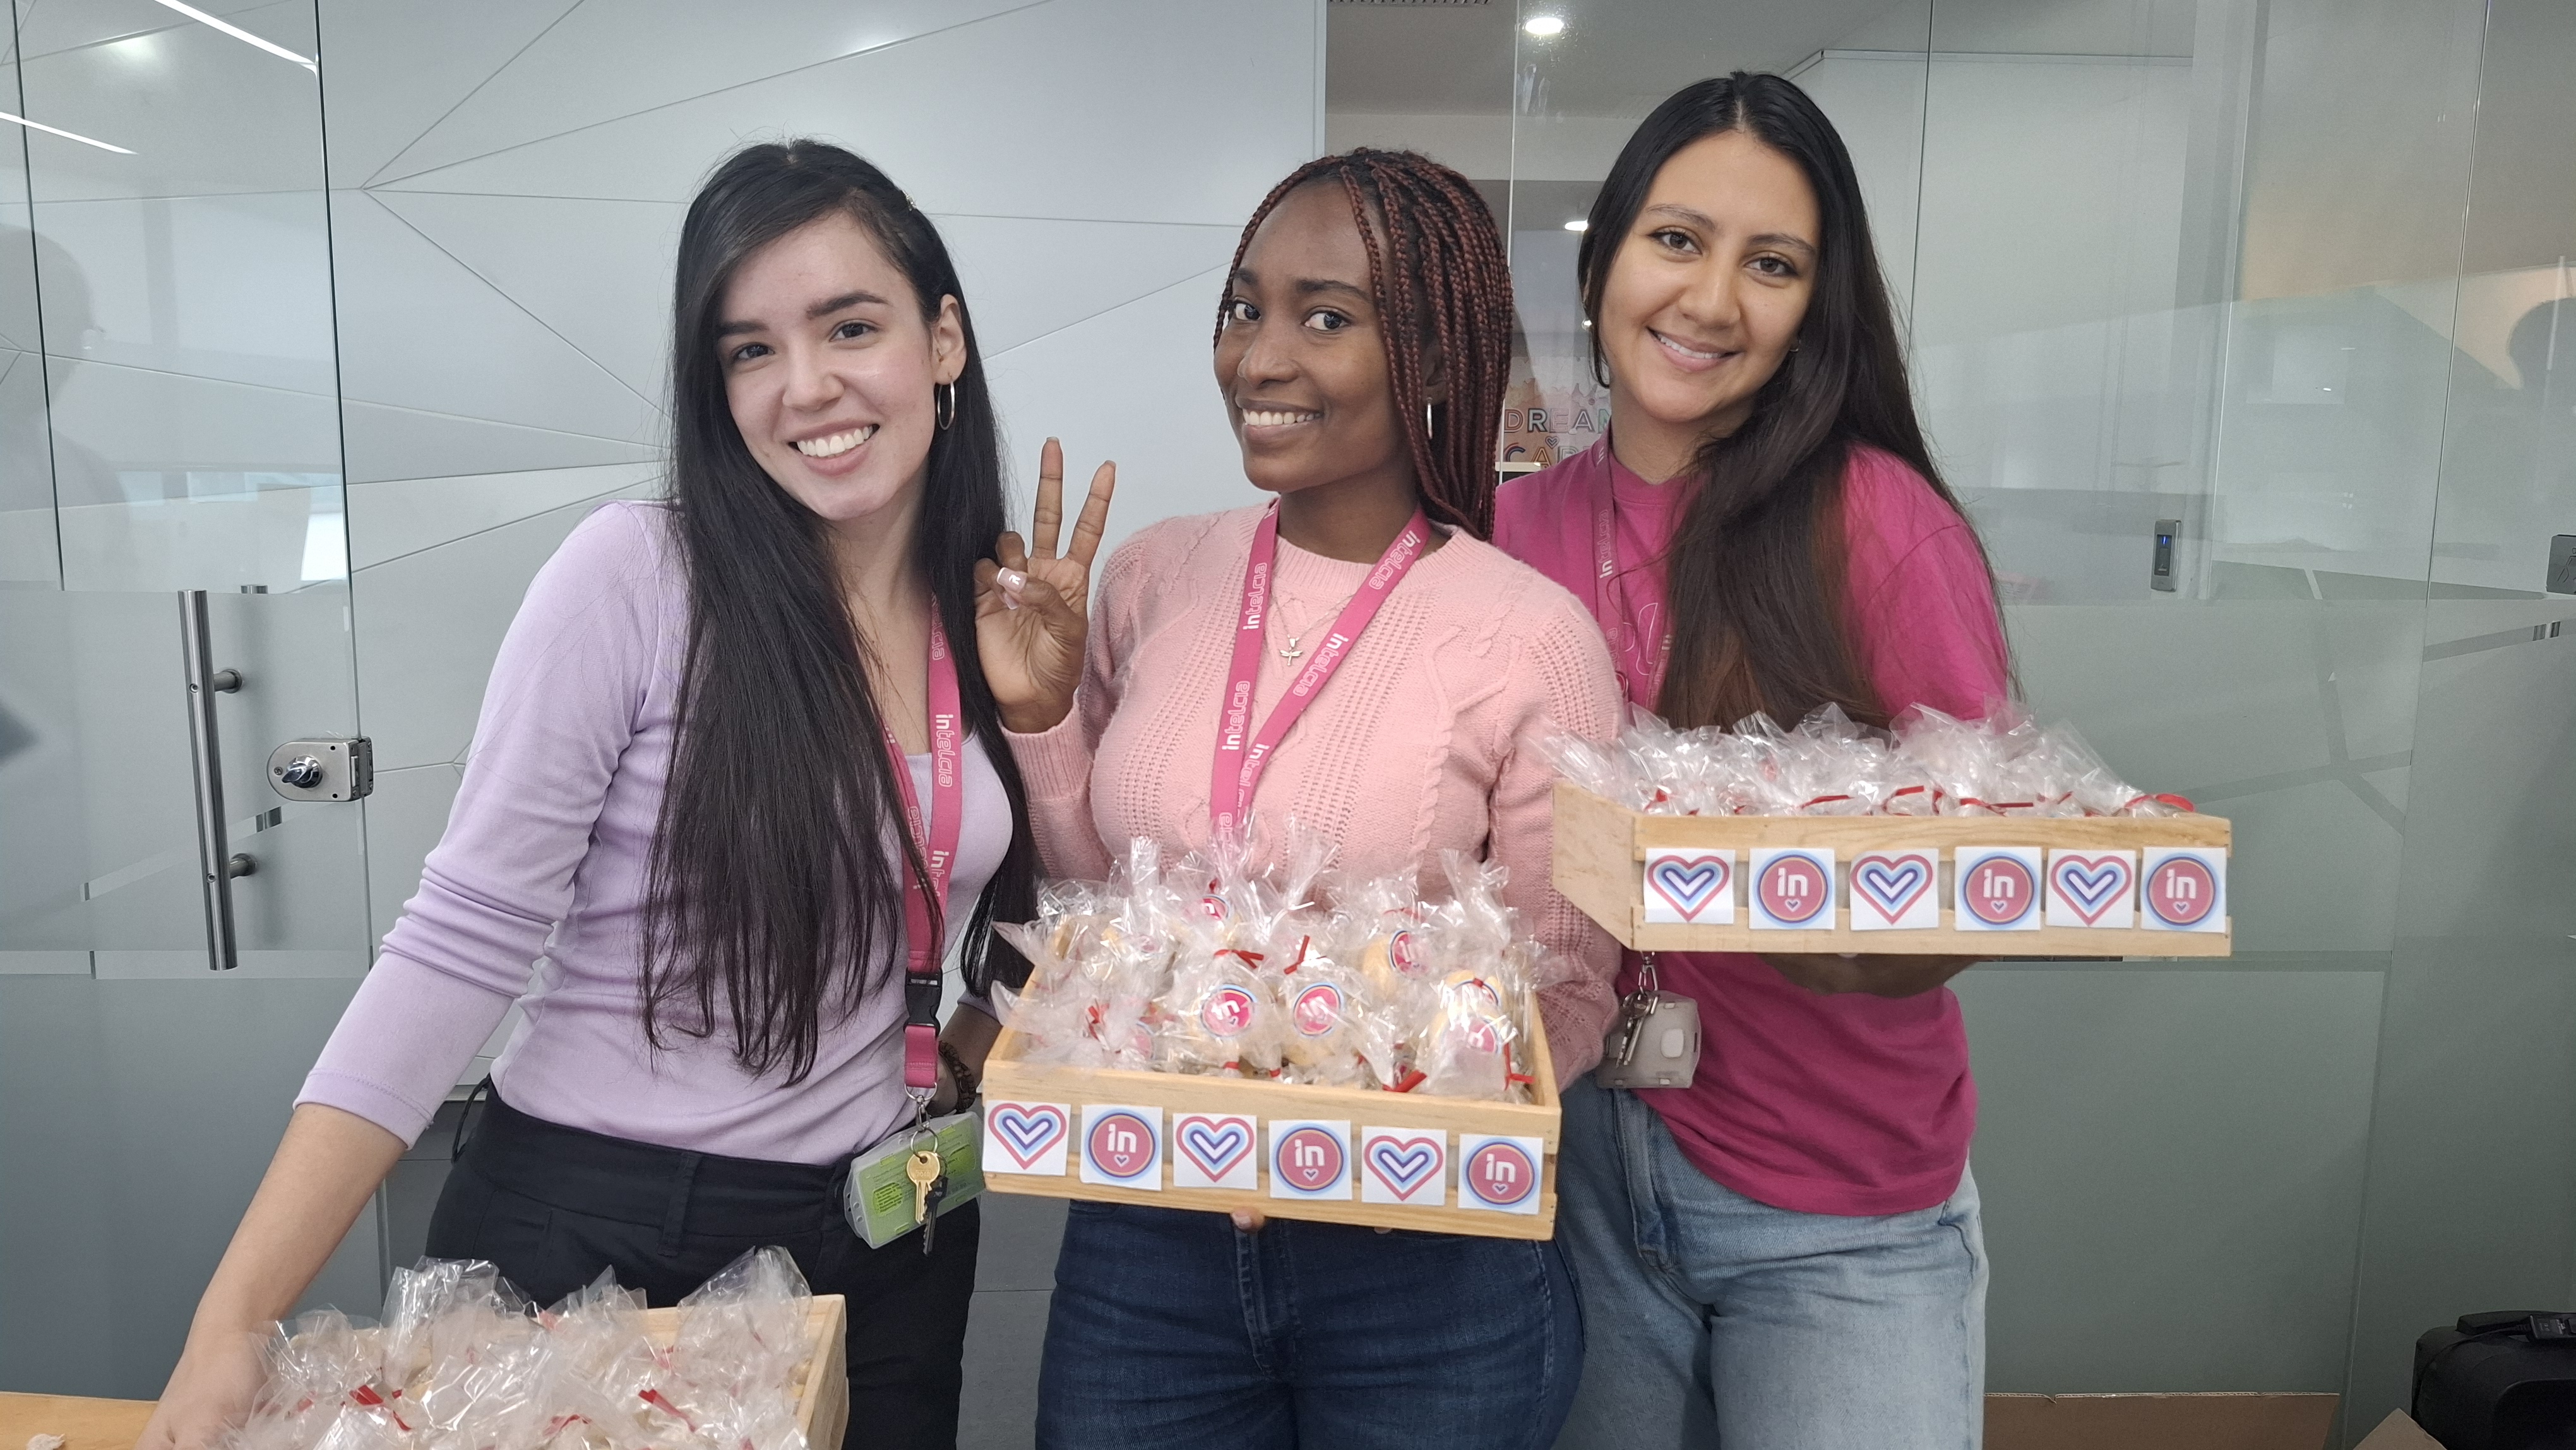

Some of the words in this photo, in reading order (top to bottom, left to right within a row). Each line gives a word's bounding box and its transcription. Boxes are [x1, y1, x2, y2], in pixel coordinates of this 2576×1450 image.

[1368, 530, 1421, 590] intelcia
[1242, 562, 1268, 630] intelcia
[1292, 633, 1349, 697] intelcia
[1222, 680, 1251, 750] intelcia
[935, 714, 955, 788] intelcia
[1777, 866, 1810, 897] in
[1983, 867, 2015, 899] in
[2164, 867, 2197, 901] in
[1107, 1123, 1138, 1154] in
[1294, 1139, 1325, 1168] in
[1485, 1153, 1517, 1184] in
